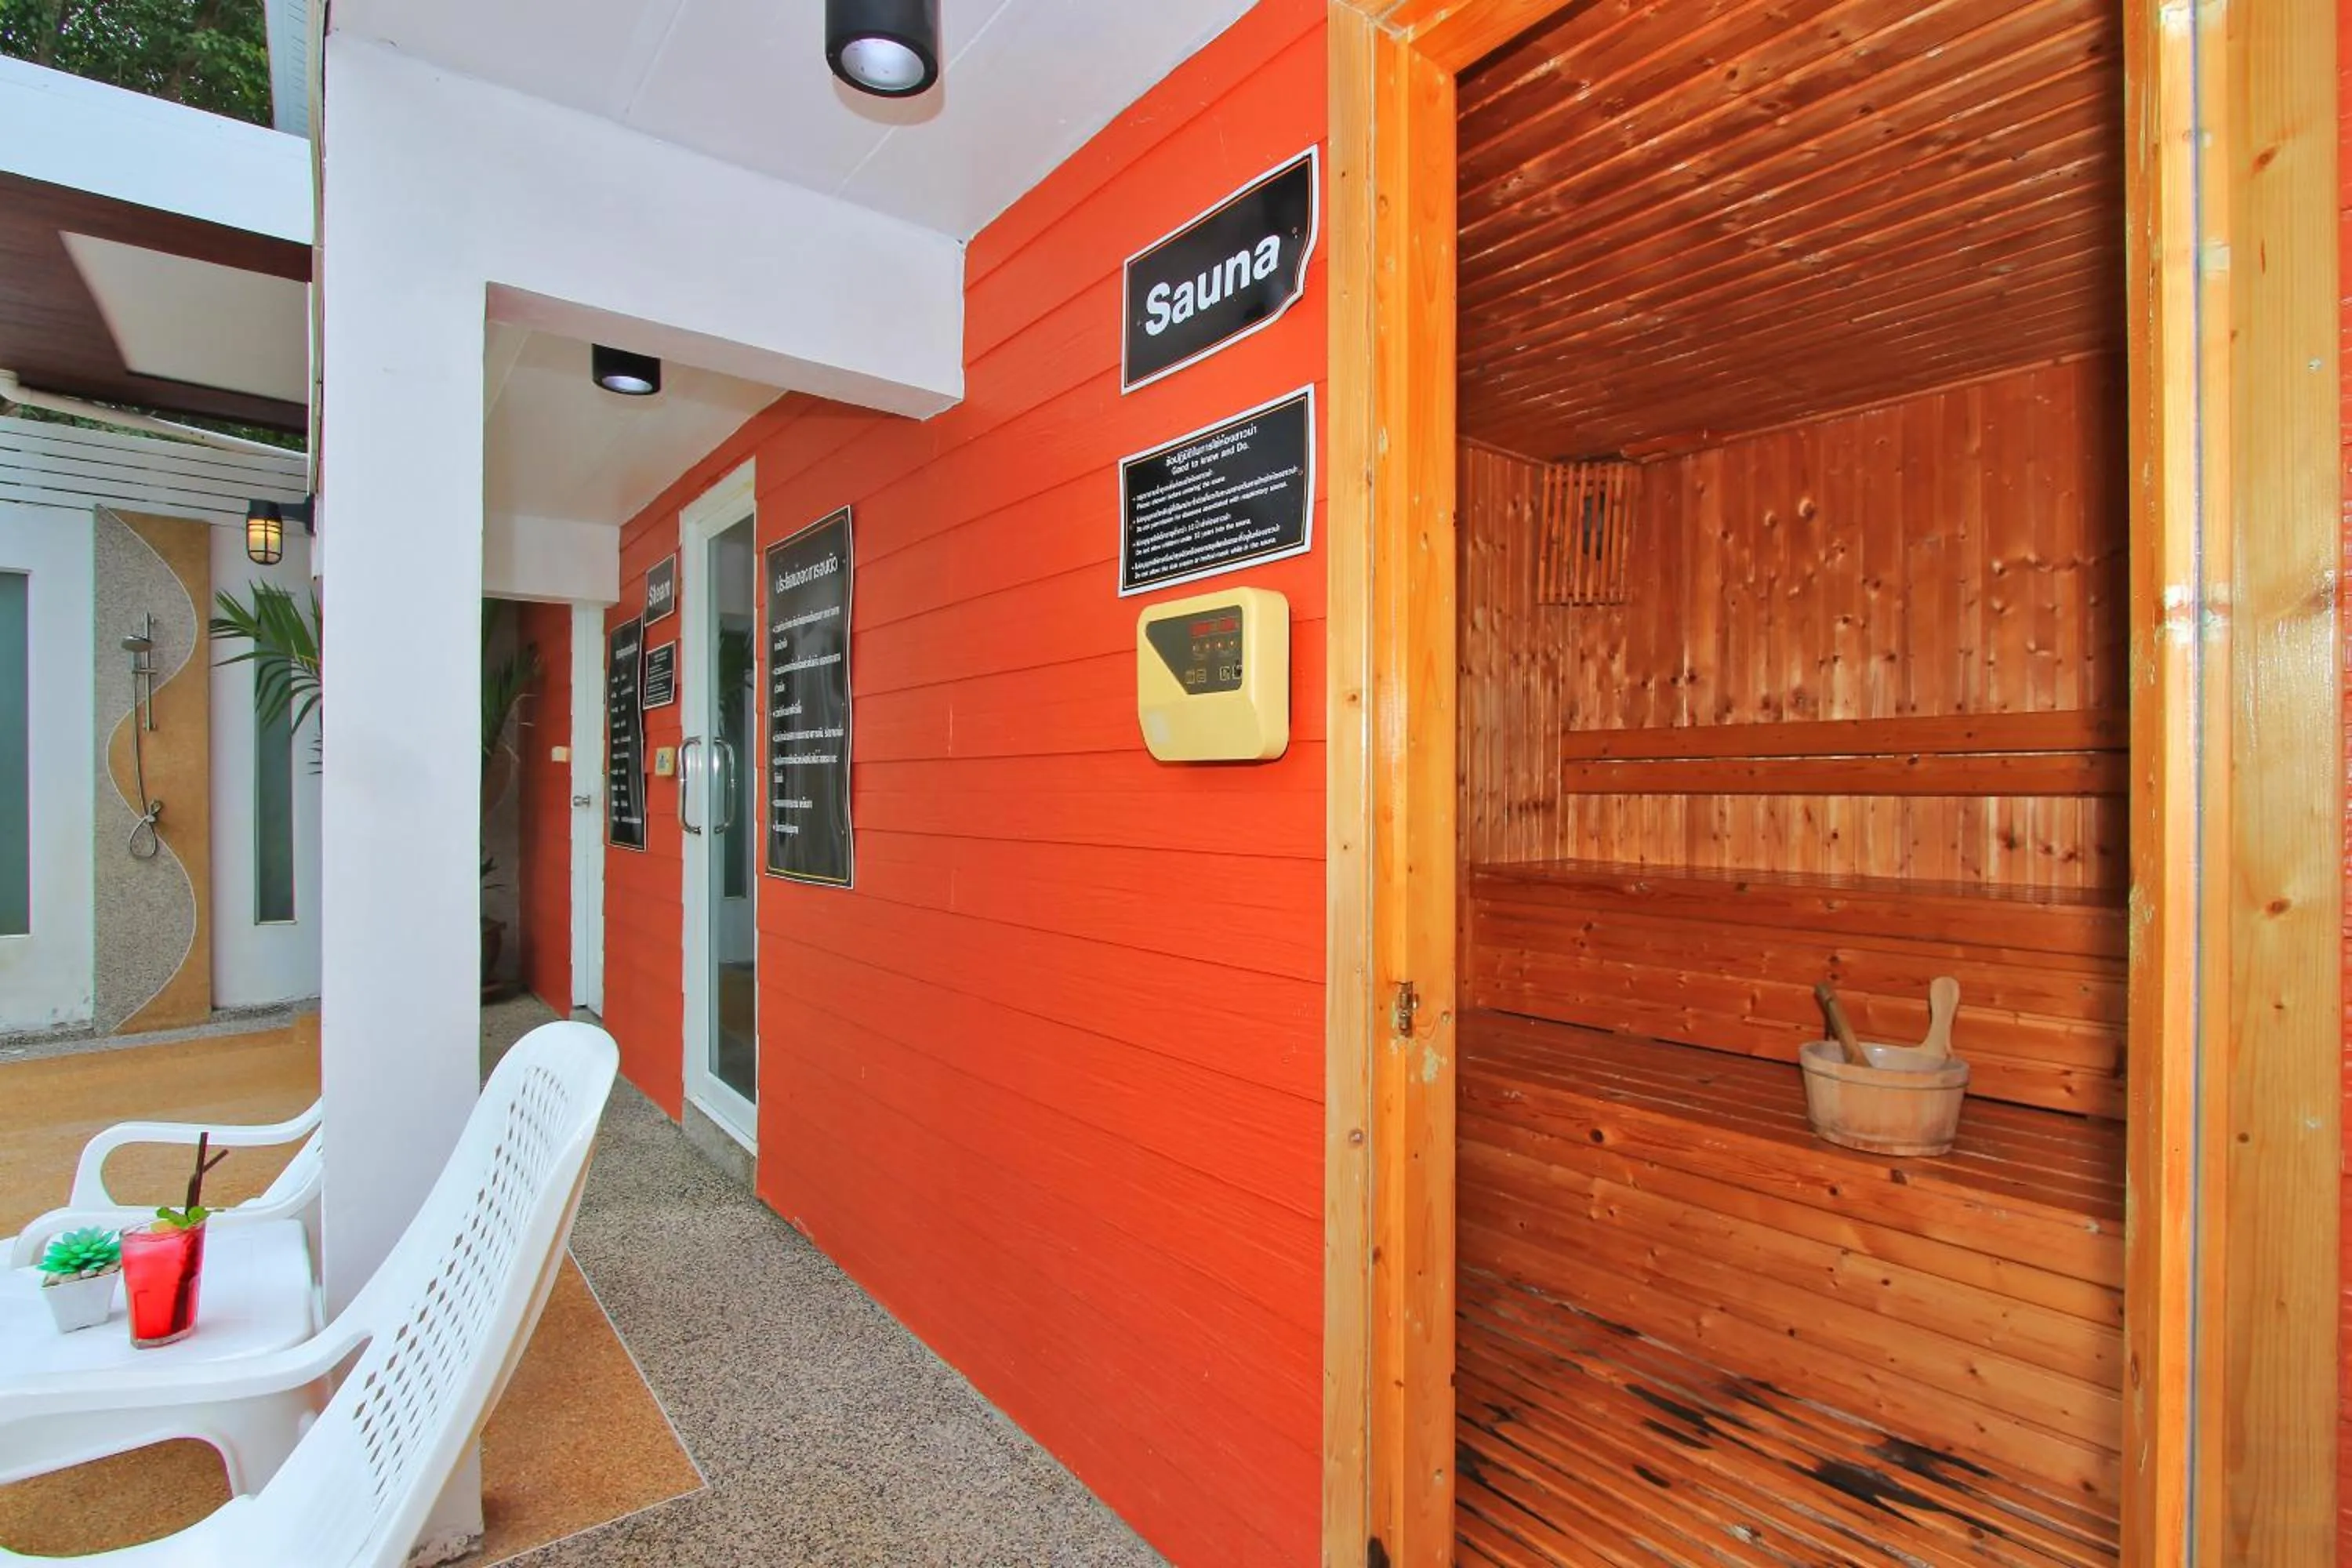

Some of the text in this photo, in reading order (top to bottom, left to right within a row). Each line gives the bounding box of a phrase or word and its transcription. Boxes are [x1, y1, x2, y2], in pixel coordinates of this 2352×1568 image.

[1145, 234, 1280, 337] Sauna
[1171, 461, 1189, 475] Good
[1191, 459, 1198, 468] to
[1200, 451, 1218, 465] know
[1221, 445, 1234, 458] and
[648, 579, 670, 608] Steam
